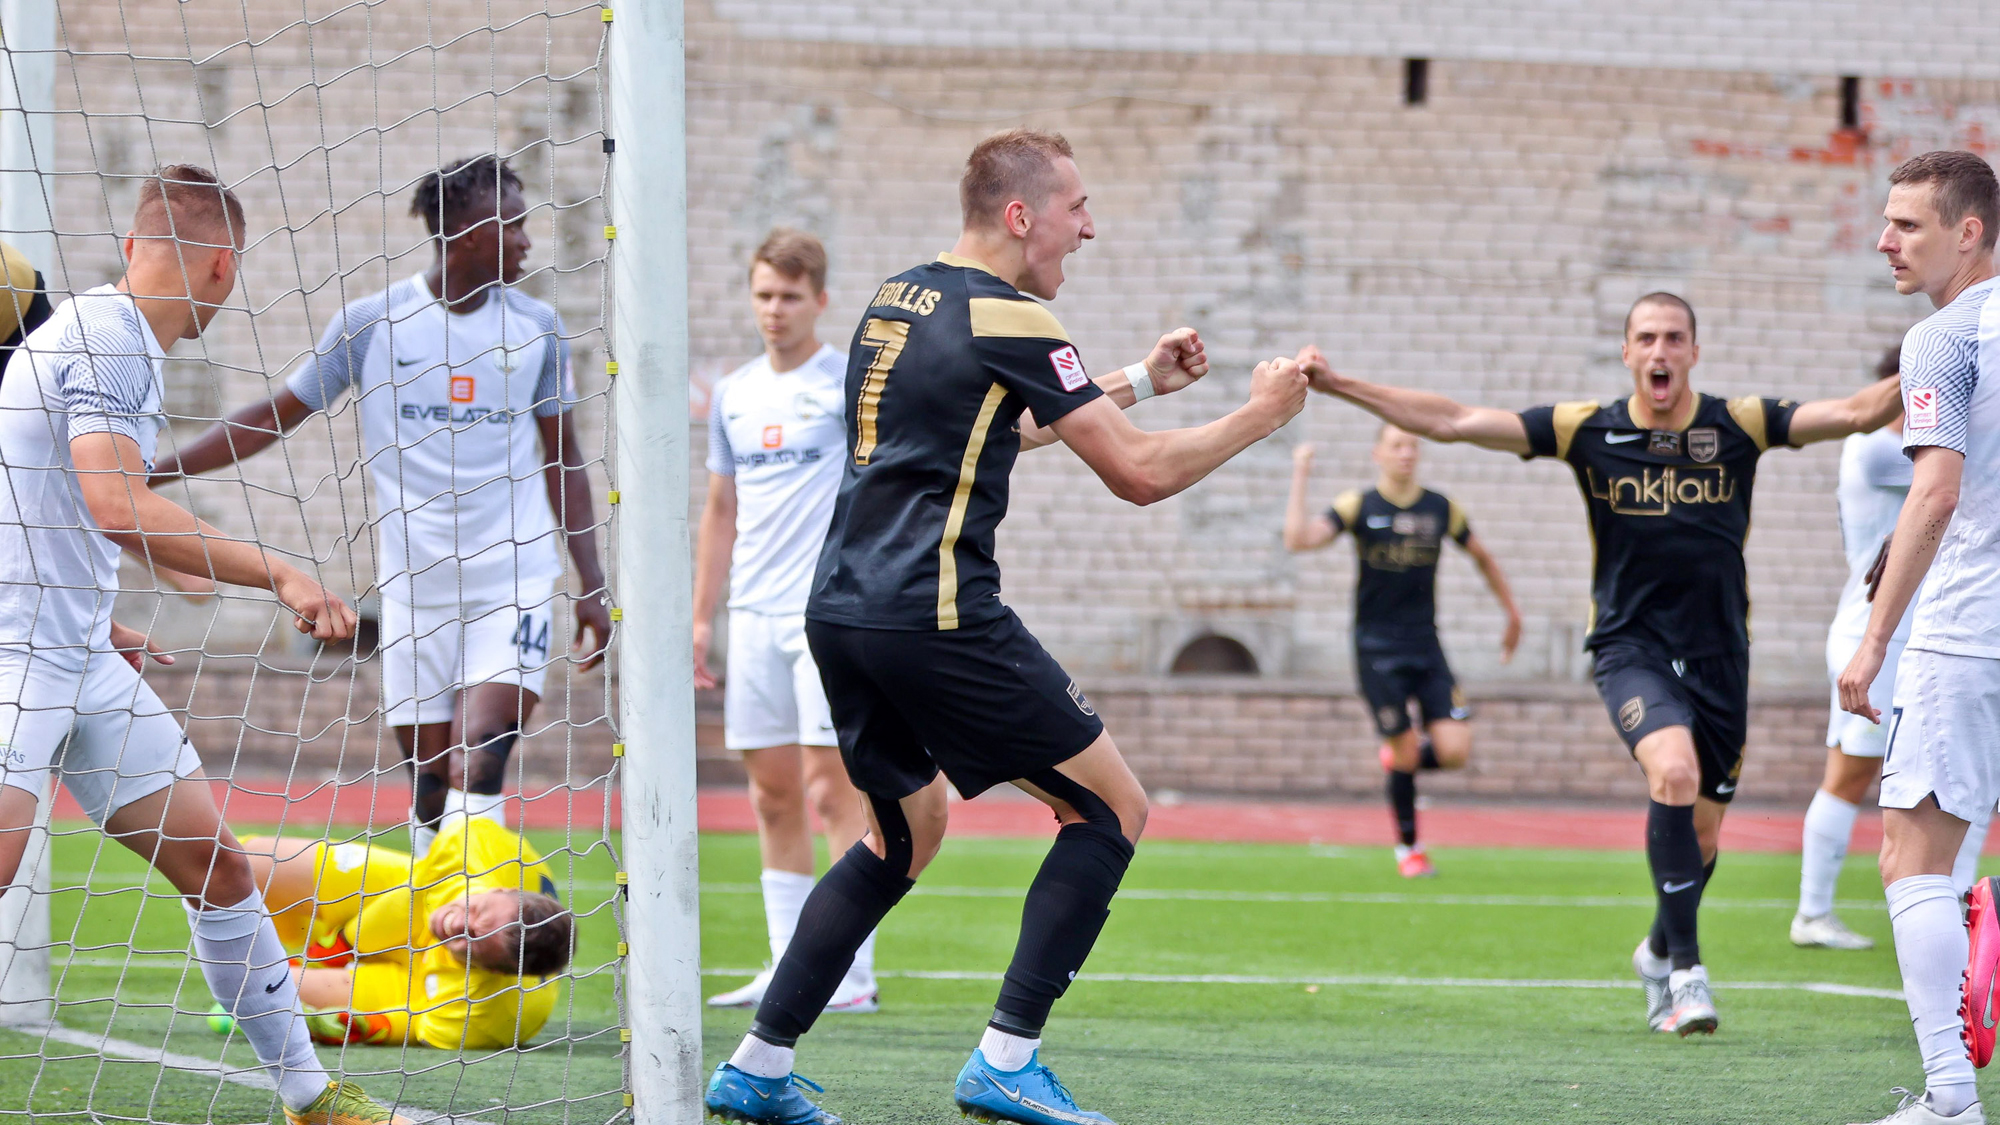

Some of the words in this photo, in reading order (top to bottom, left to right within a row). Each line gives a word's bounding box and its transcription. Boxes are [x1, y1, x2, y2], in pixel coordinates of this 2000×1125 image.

[401, 404, 515, 424] EVELATUS
[854, 318, 911, 466] 7
[512, 613, 548, 662] 44
[1886, 706, 1903, 763] 7
